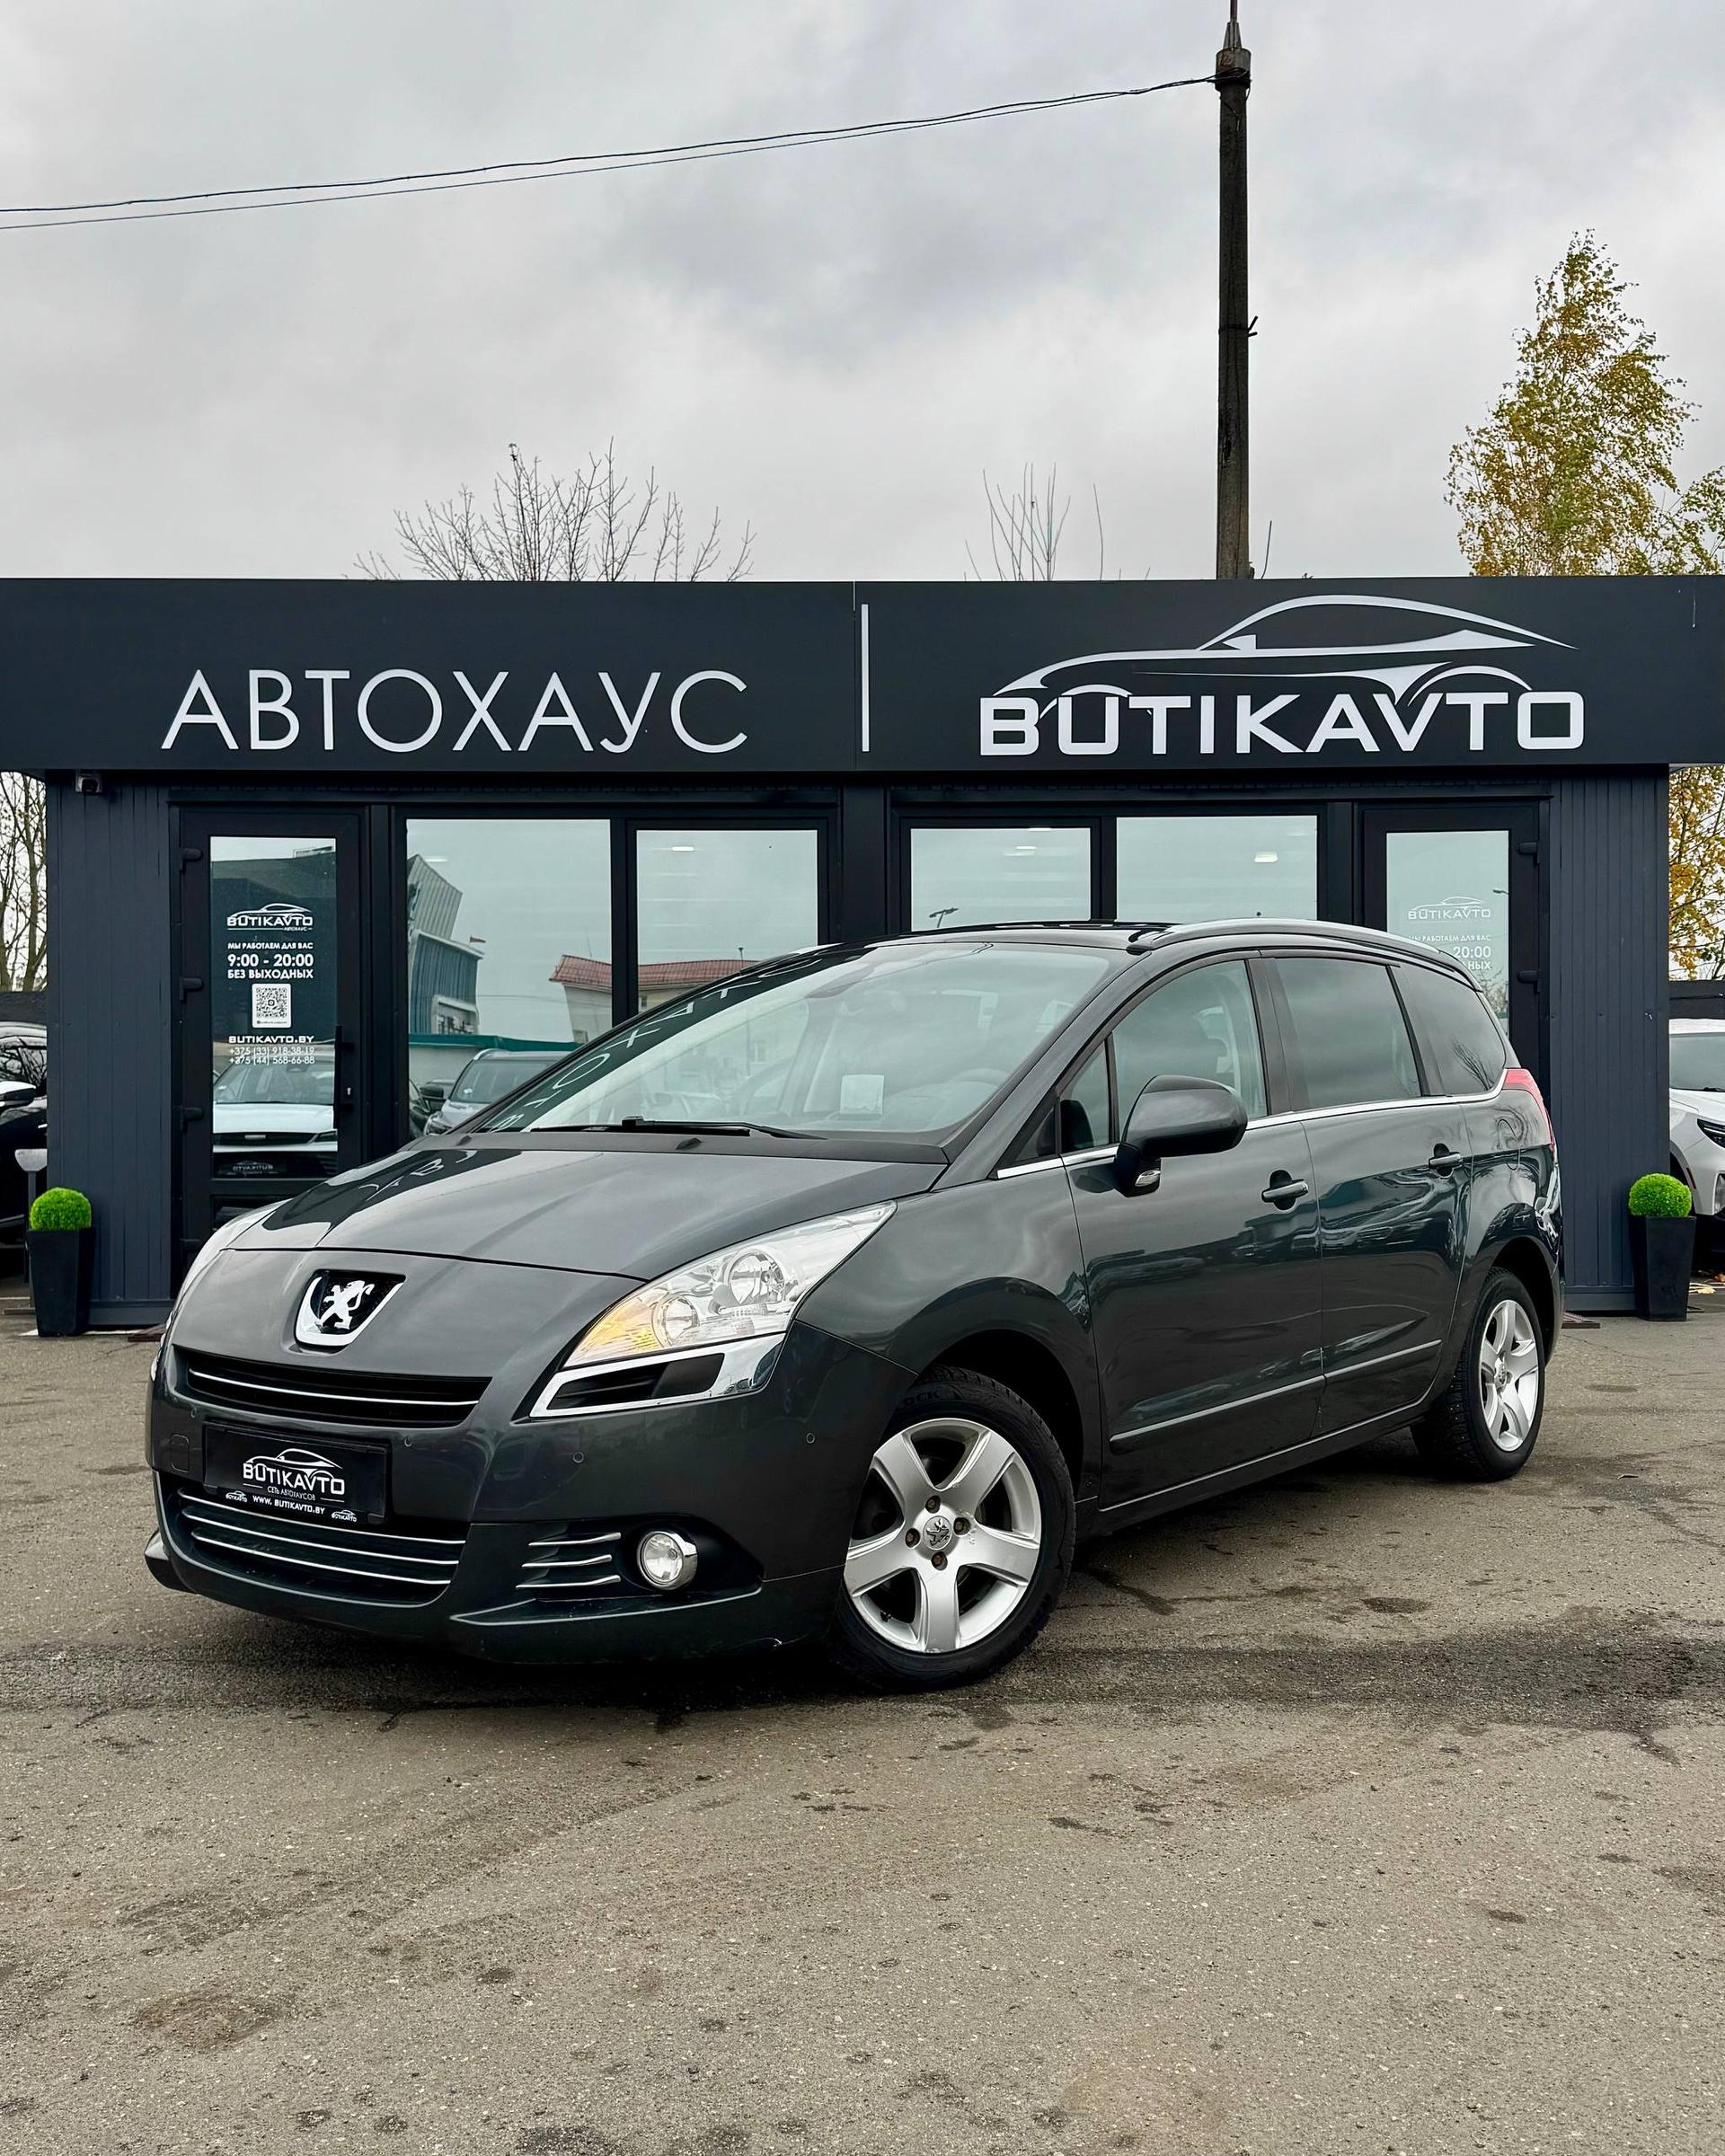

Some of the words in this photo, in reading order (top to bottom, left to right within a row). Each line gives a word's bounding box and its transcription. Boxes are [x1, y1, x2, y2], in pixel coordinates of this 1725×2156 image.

[161, 668, 748, 754] АВТОХАУС
[980, 691, 1584, 756] BUTIKAVTO
[1408, 908, 1491, 919] BUTIKAVTO
[226, 916, 314, 927] BUTIKAVTO
[281, 942, 296, 950] ДЛЯ
[1453, 946, 1491, 959] 20:00
[227, 953, 260, 968] 9:00
[273, 953, 314, 968] 20:00
[227, 969, 246, 979] БЕЗ
[248, 969, 314, 980] ВЫХОДНЫХ
[228, 1035, 314, 1044] BUTIKAVTO.BY
[229, 1047, 251, 1056] +375
[253, 1047, 270, 1057] (33)
[272, 1047, 315, 1056] 918-38-19
[253, 1056, 270, 1066] (44)
[272, 1056, 315, 1065] 568-66-88
[243, 1462, 345, 1495] BUTIKAVTO
[252, 1495, 272, 1506] WWW.
[274, 1499, 325, 1515] BUTIKAVTO.BY
